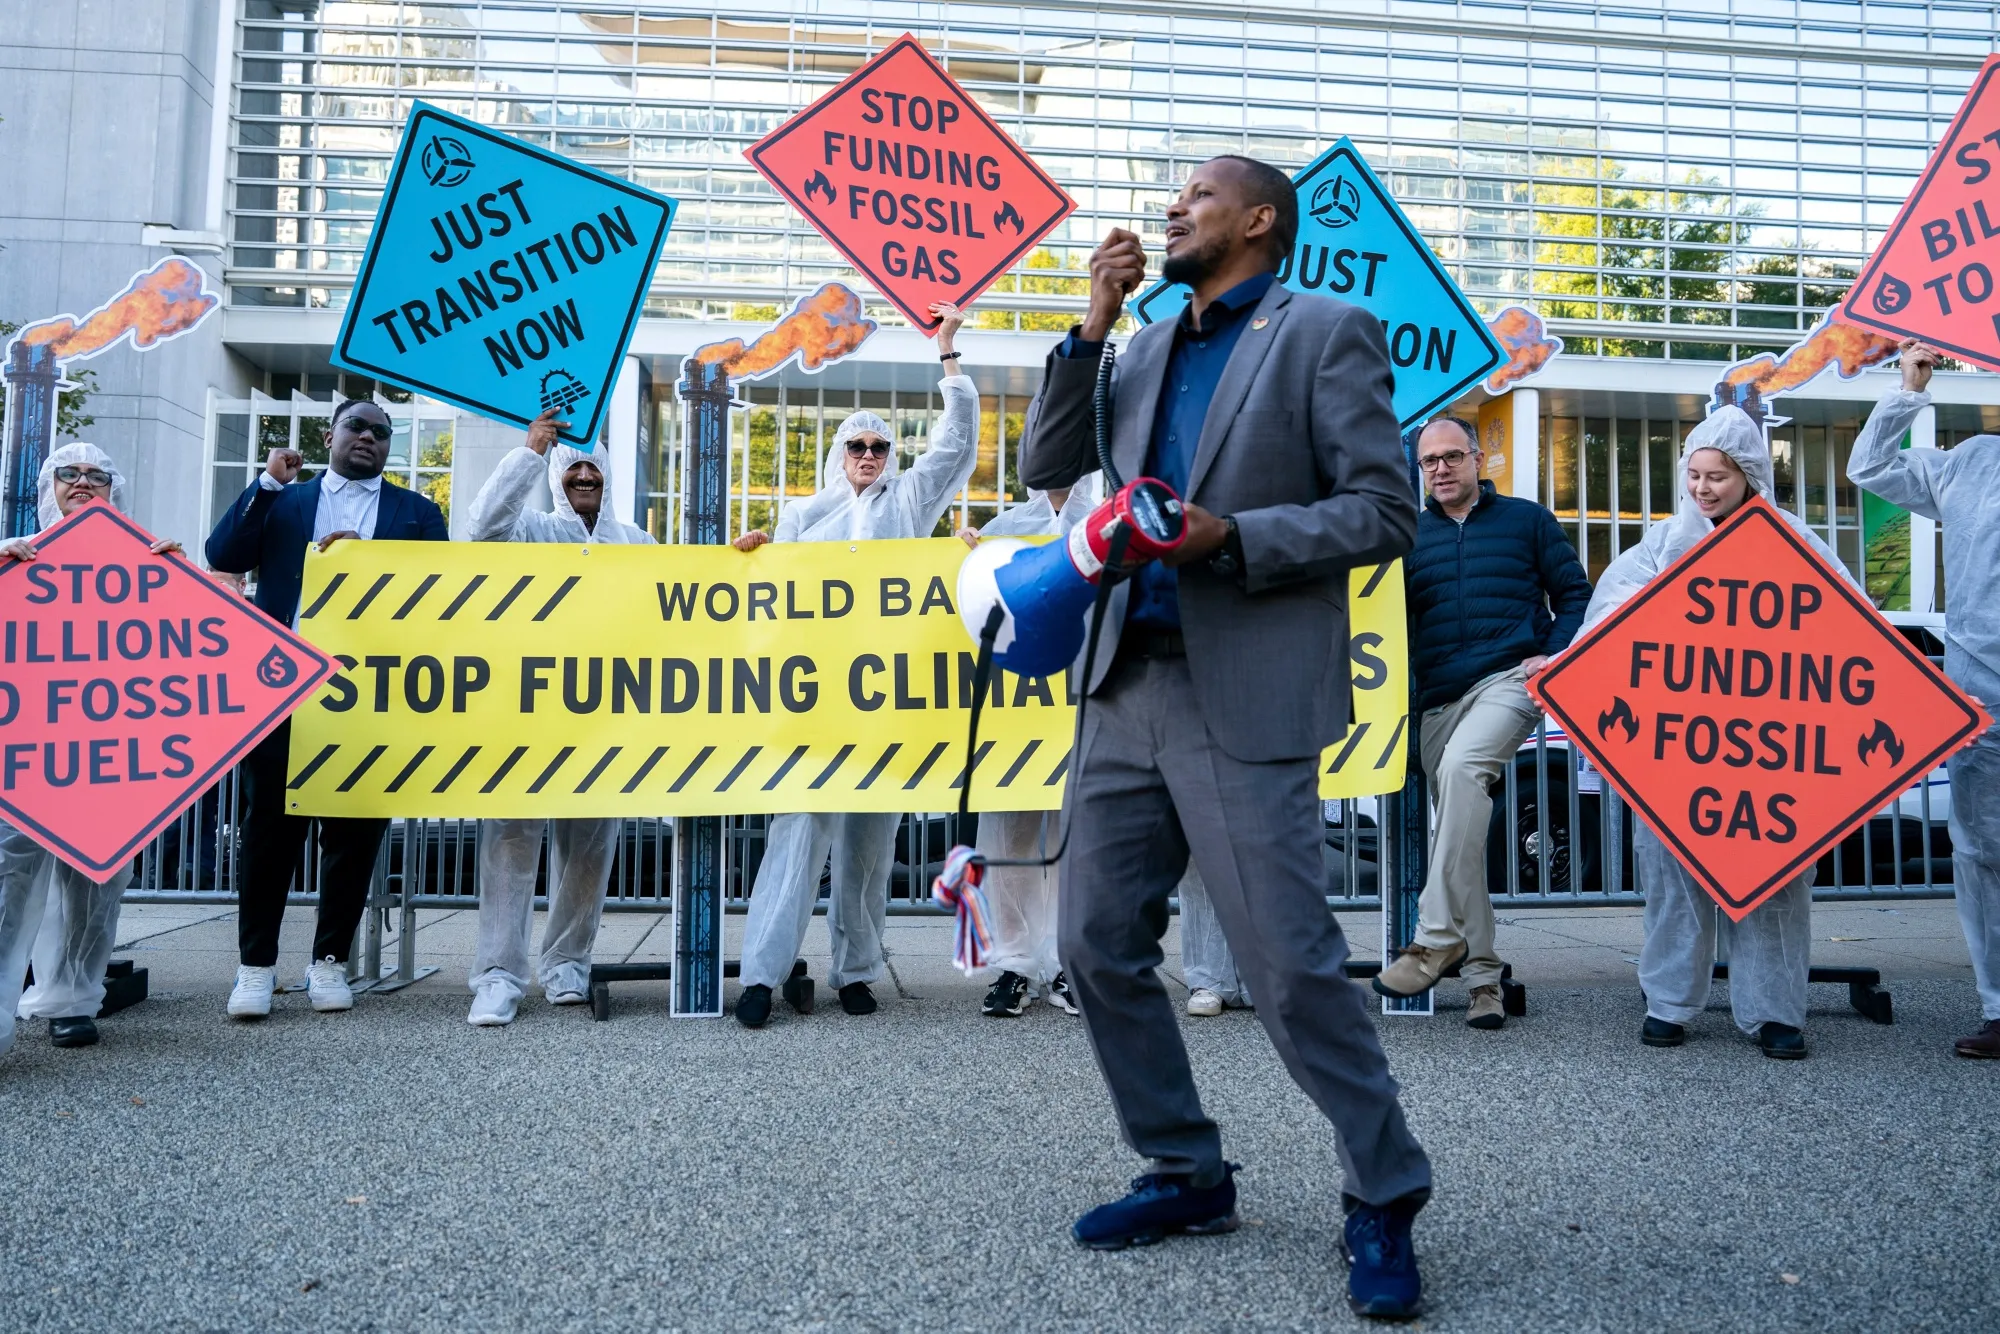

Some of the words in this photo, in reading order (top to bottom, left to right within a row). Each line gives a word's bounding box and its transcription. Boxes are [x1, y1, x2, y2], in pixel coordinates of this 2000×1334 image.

[861, 88, 960, 134] STOP
[824, 130, 1001, 191] FUNDING
[430, 179, 532, 263] JUST
[848, 184, 985, 239] FOSSIL
[372, 205, 638, 354] TRANSITION
[881, 241, 961, 286] GAS
[1923, 262, 1993, 316] TO
[483, 299, 585, 377] NOW
[25, 563, 169, 604] STOP
[656, 579, 855, 621] WORLD
[879, 576, 956, 617] BA
[1684, 577, 1823, 631] STOP
[4, 617, 229, 663] ILLIONS
[1350, 632, 1388, 691] S
[47, 673, 245, 724] FOSSIL
[319, 654, 491, 714] STOP
[519, 655, 819, 714] FUNDING
[1630, 641, 1875, 706] FUNDING
[4, 734, 195, 791] FUELS
[1654, 712, 1841, 775] FOSSIL
[1688, 786, 1797, 844] GAS
